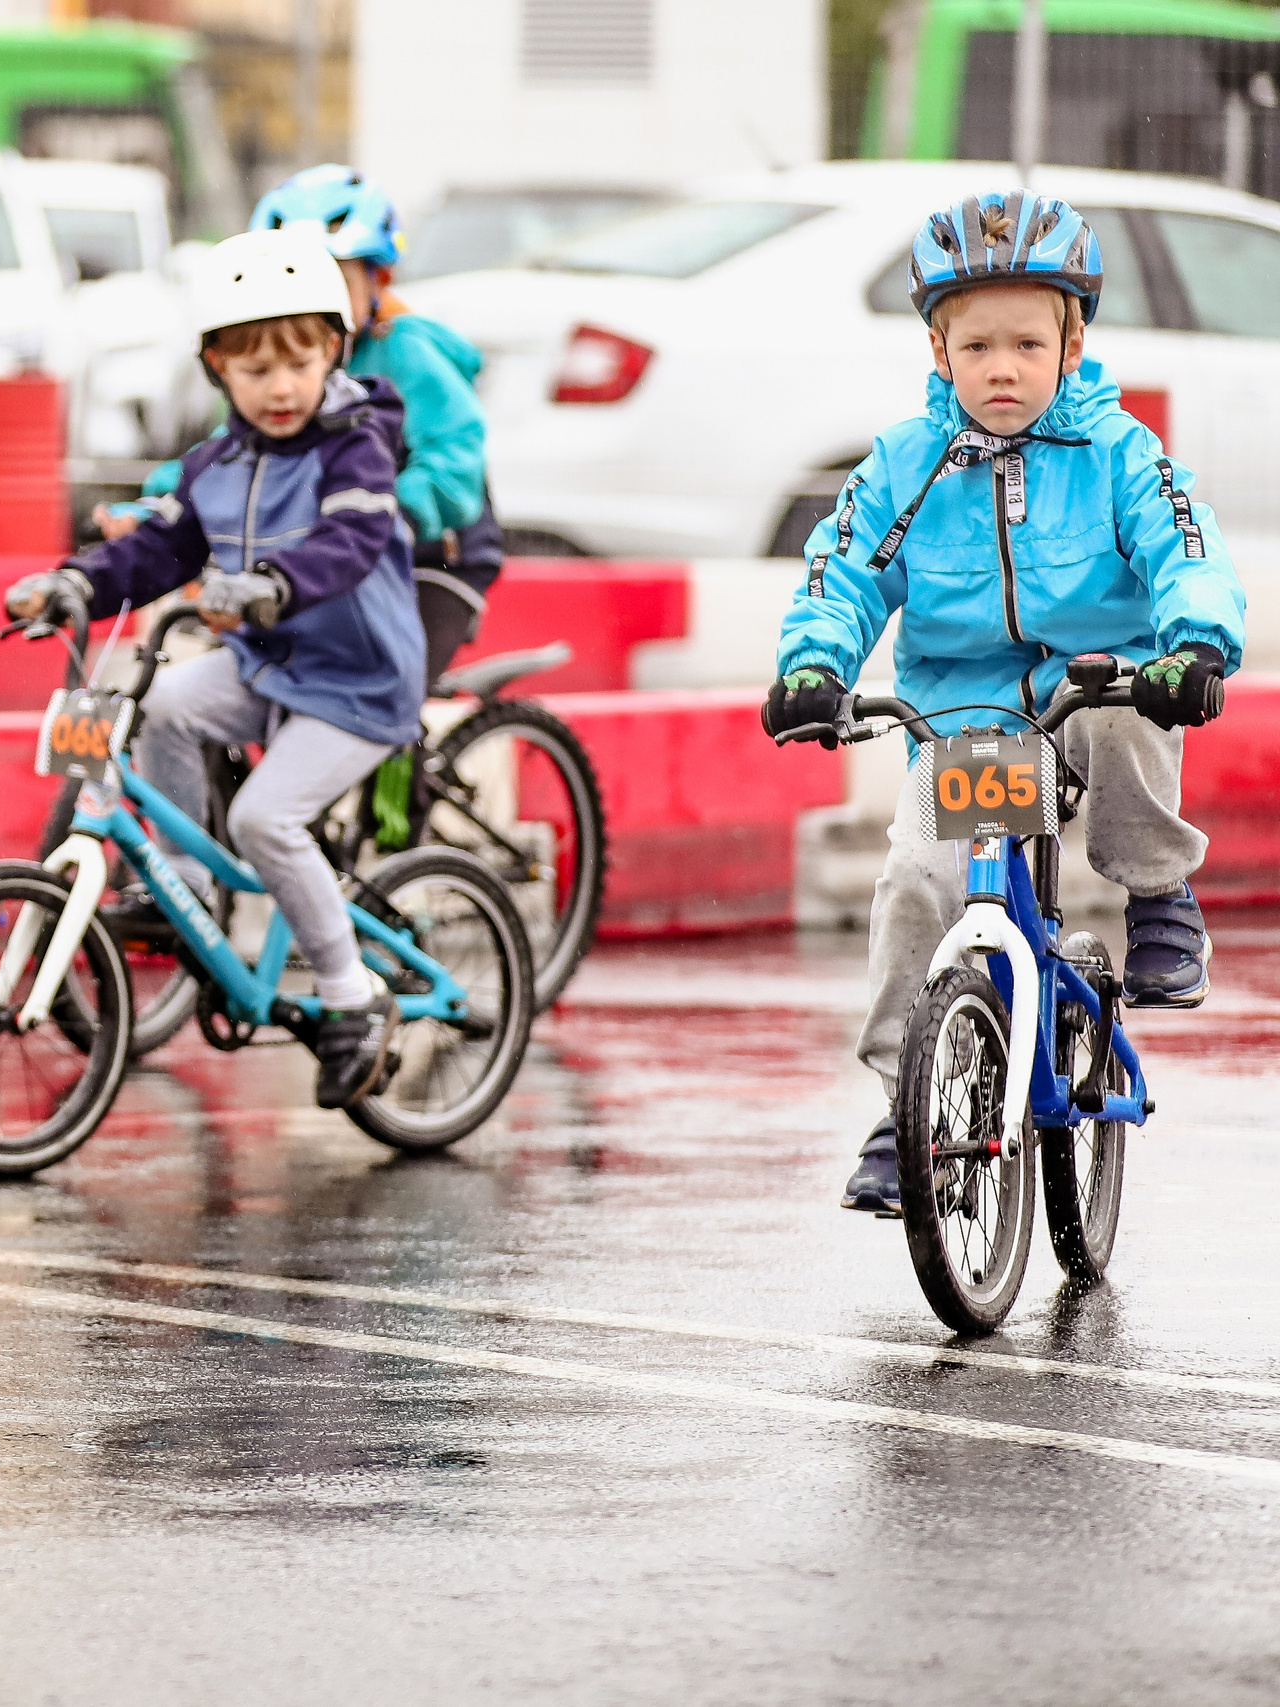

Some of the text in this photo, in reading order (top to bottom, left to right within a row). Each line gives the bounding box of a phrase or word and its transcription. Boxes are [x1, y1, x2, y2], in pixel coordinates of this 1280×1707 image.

[1161, 467, 1172, 481] BY
[1172, 497, 1188, 510] BY
[838, 534, 851, 549] BY
[876, 513, 912, 560] BY EVRIKA
[811, 557, 826, 571] BY
[938, 763, 1037, 811] 065
